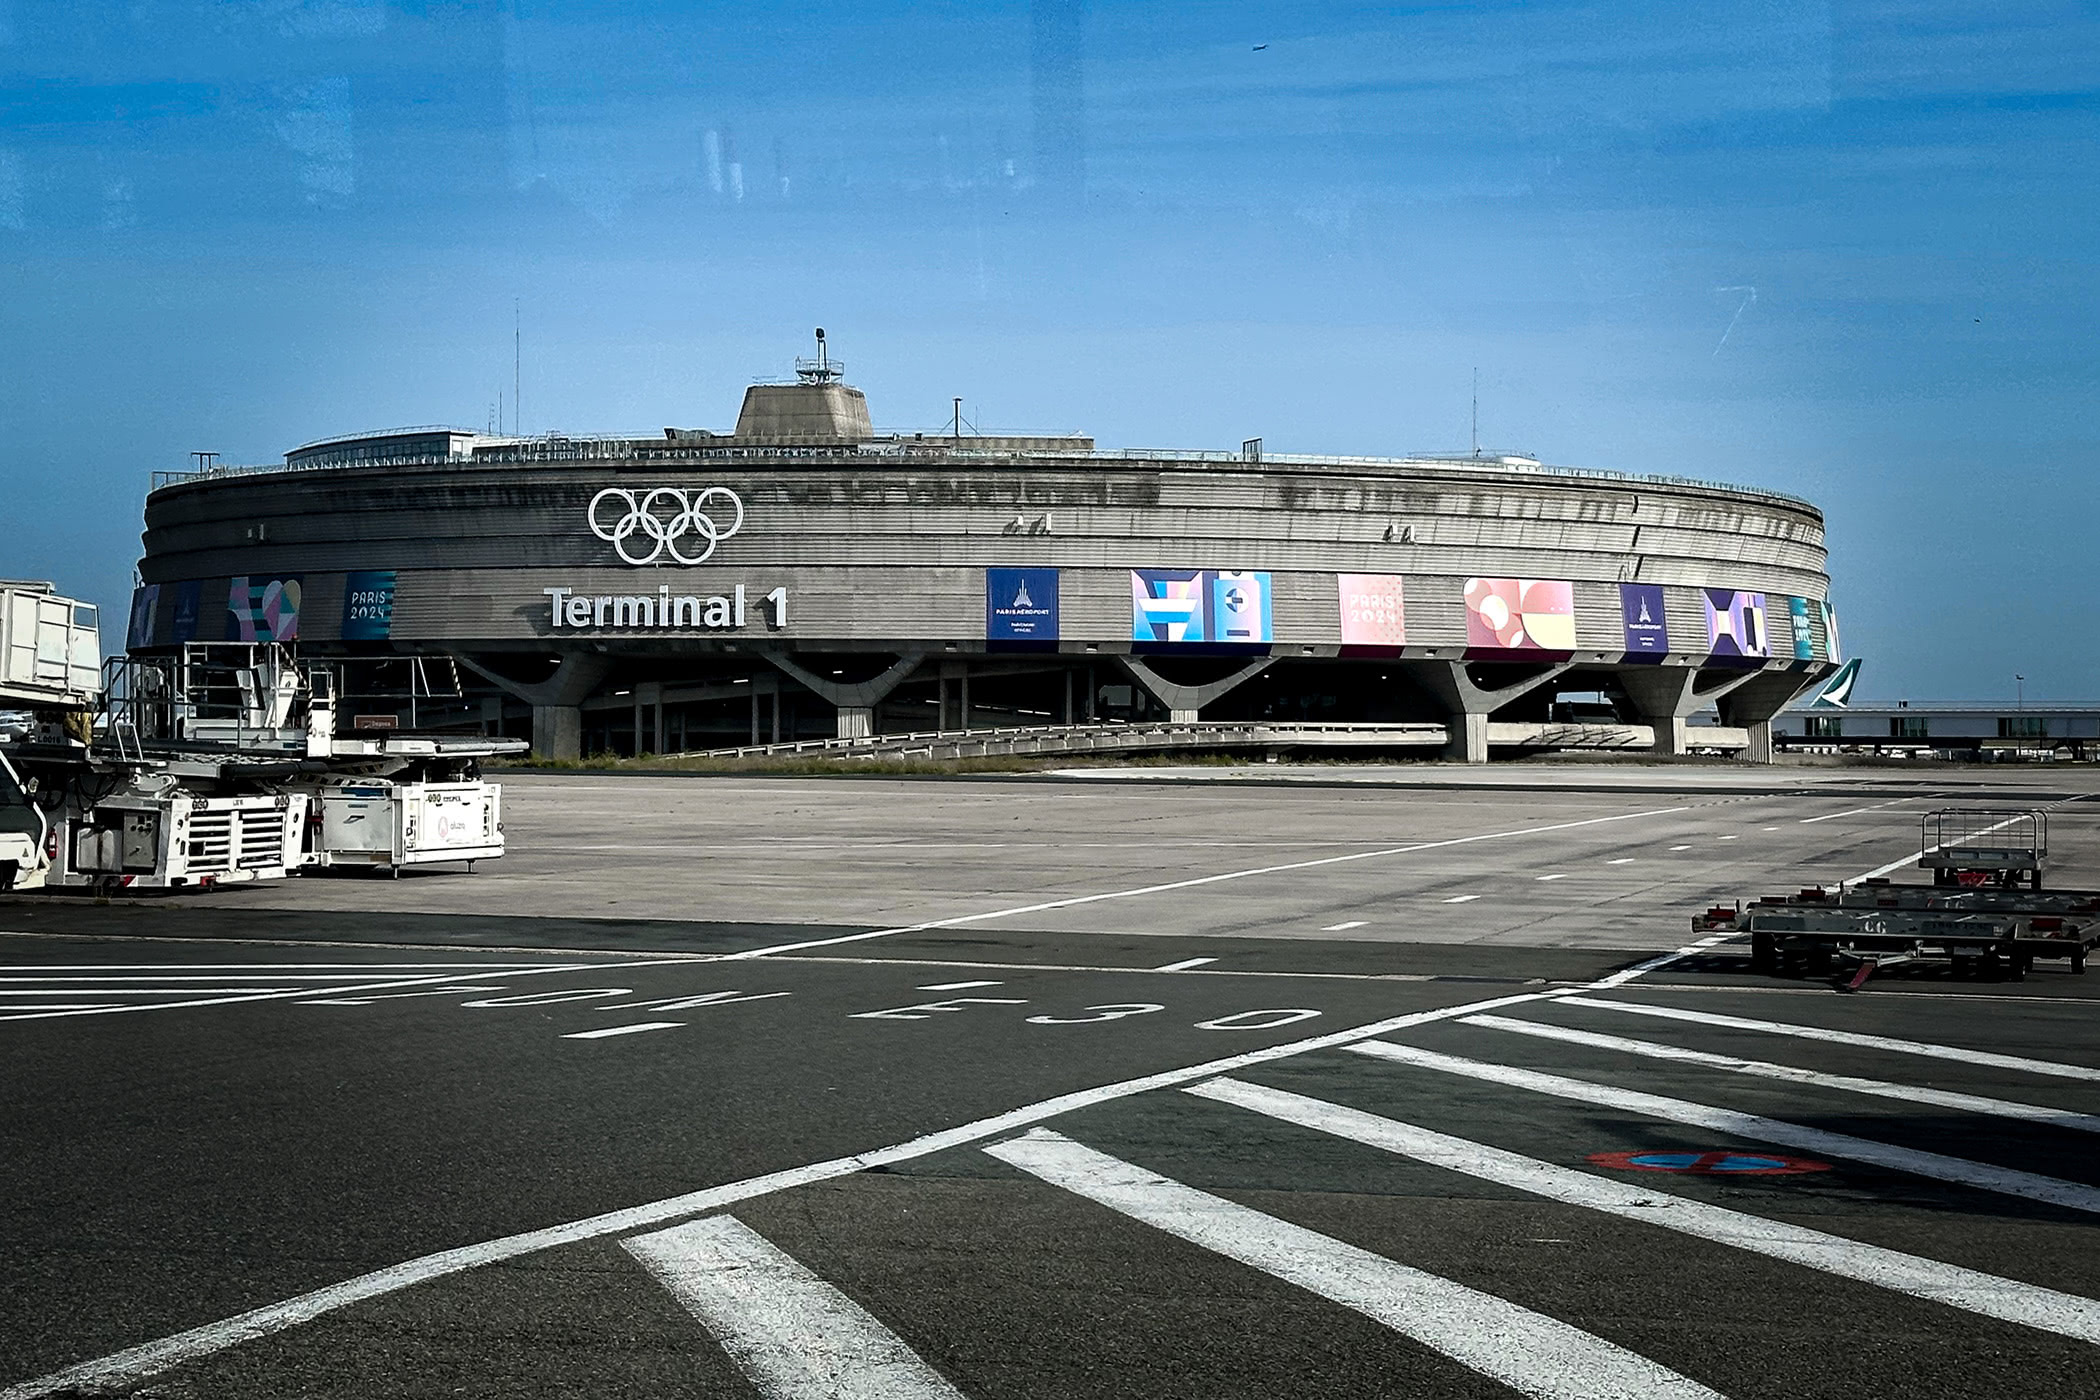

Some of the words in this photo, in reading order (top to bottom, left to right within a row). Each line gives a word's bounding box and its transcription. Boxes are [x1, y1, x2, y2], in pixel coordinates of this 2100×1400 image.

[351, 591, 386, 604] PARIS
[1350, 594, 1394, 608] PARIS
[350, 606, 385, 619] 2024
[543, 584, 745, 628] Terminal
[766, 586, 787, 627] 1
[1351, 609, 1396, 623] 2024
